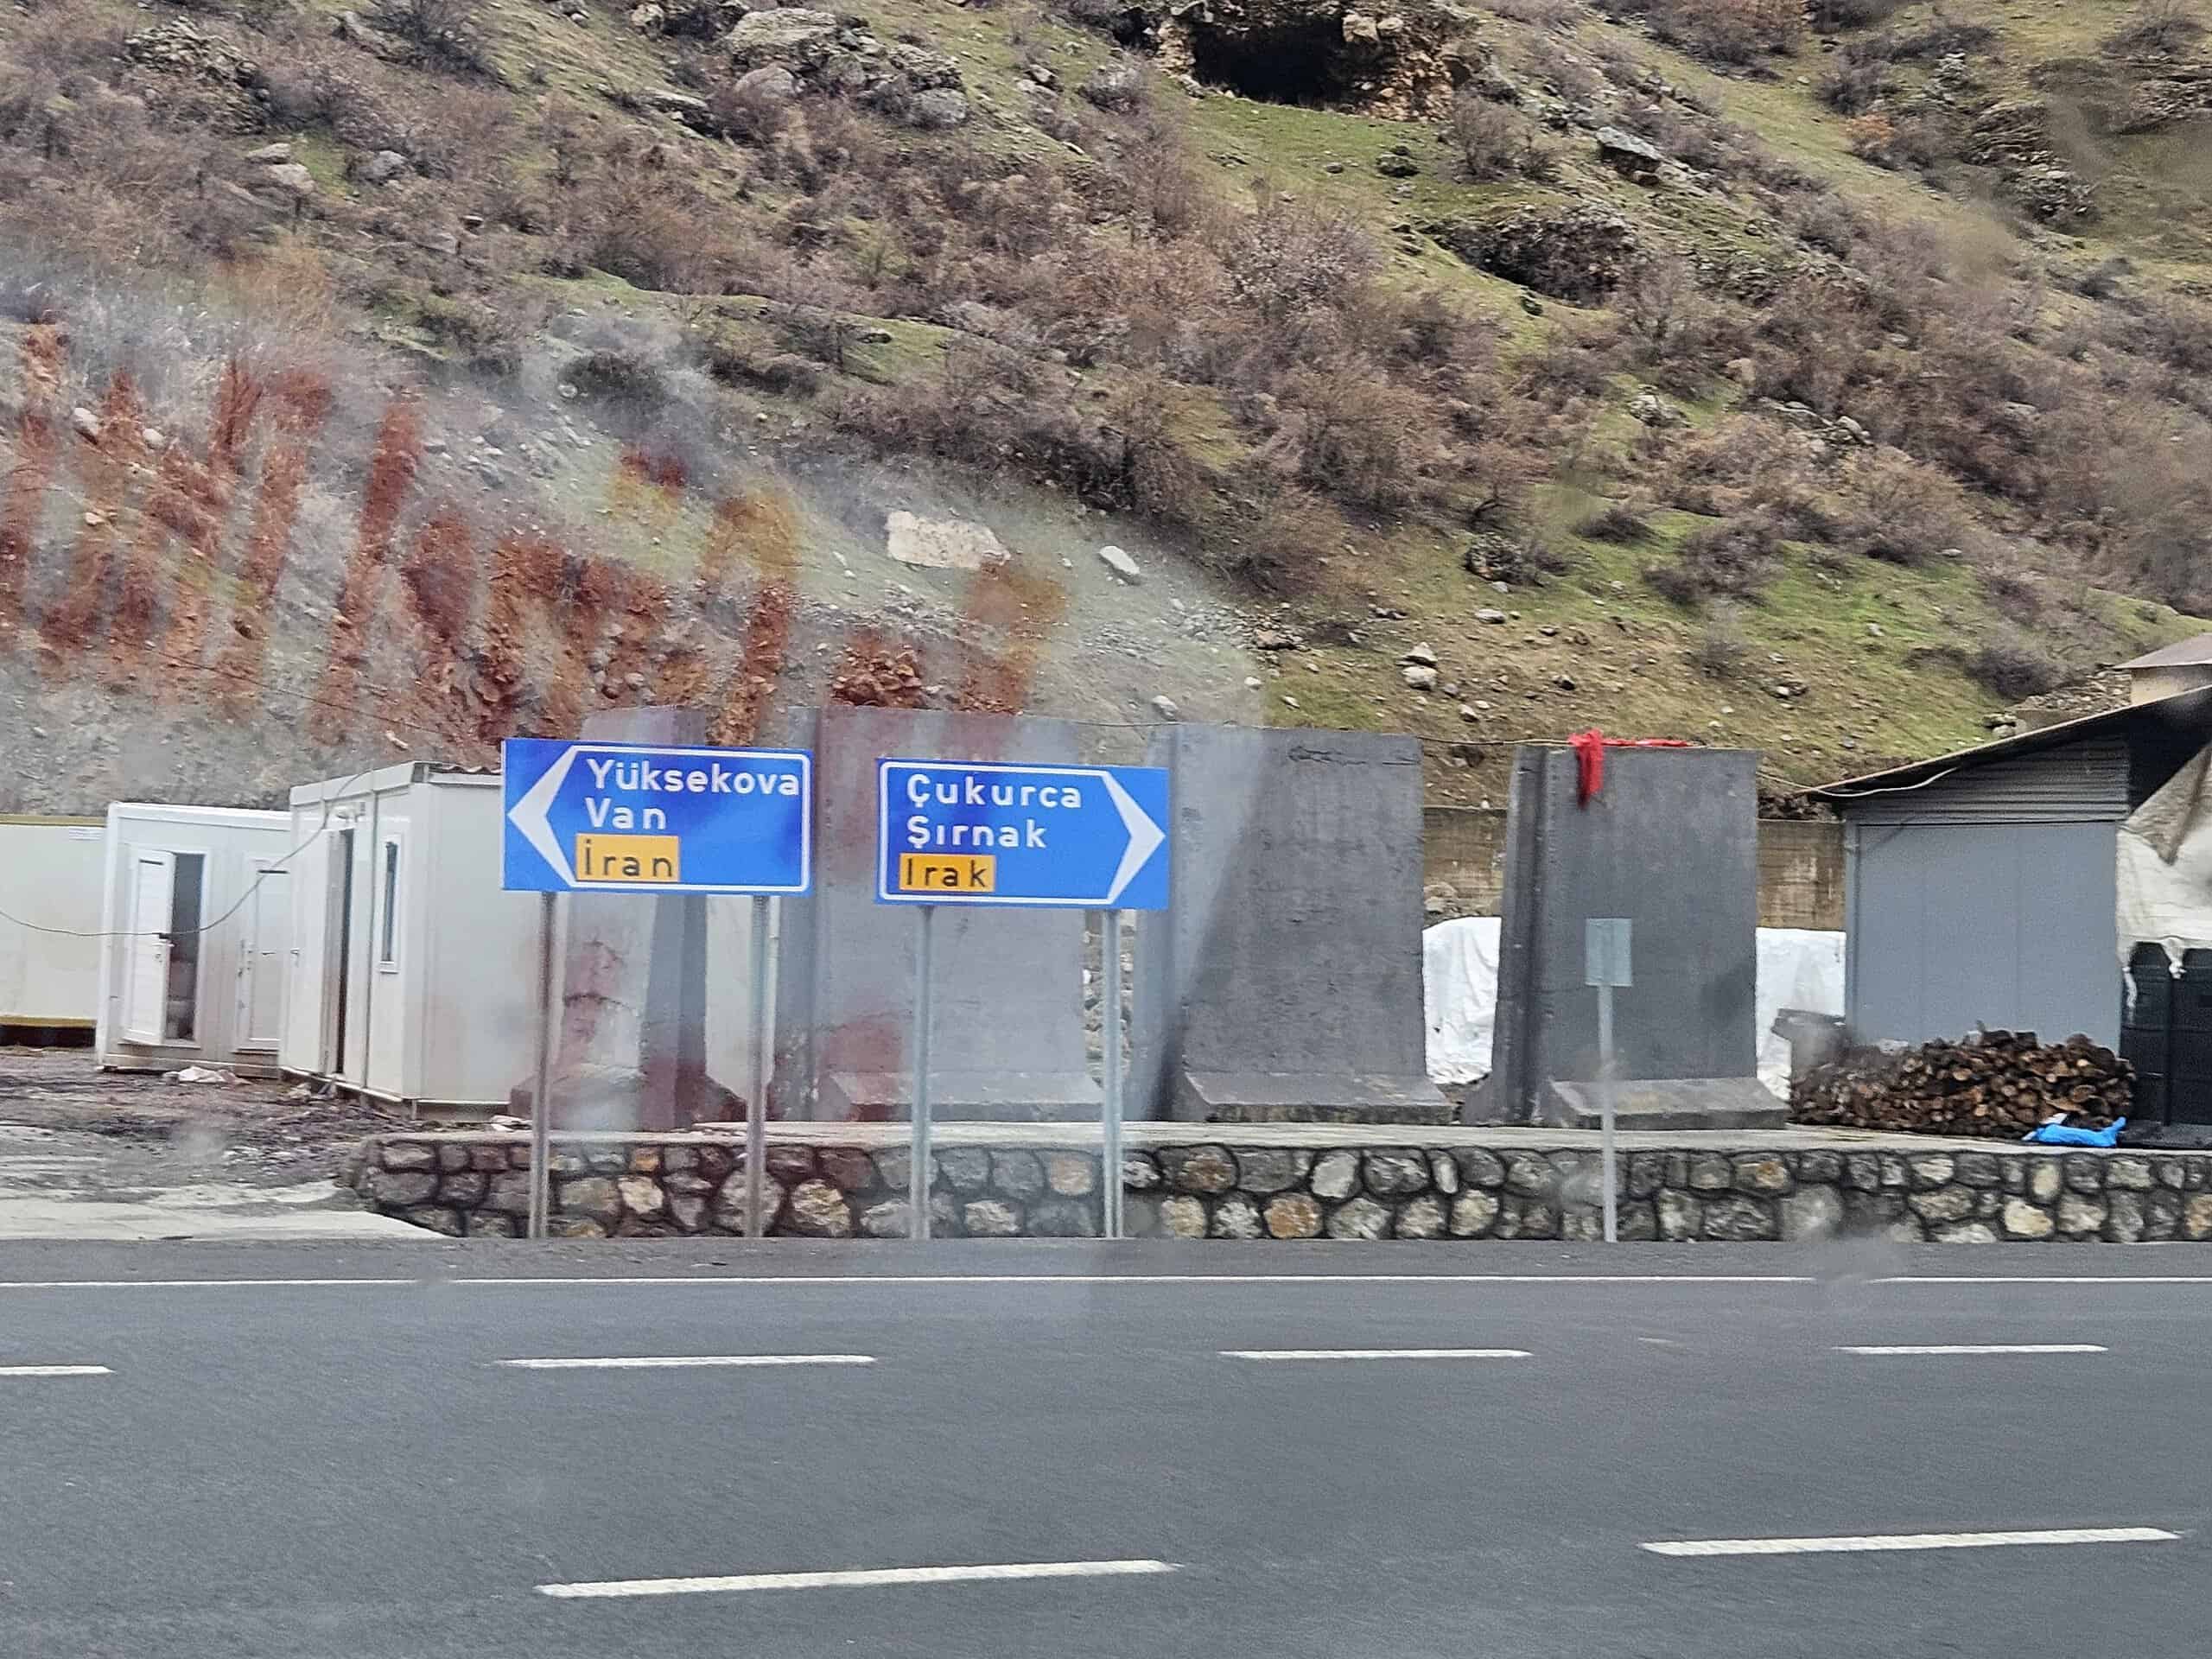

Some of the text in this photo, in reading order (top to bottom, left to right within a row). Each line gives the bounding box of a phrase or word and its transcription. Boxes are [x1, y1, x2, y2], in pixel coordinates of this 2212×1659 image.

[587, 759, 799, 796] Yüksekova
[907, 774, 1081, 808] Çukurca
[584, 798, 667, 830] Van
[907, 815, 1047, 849] Şırnak
[584, 839, 673, 877] İran
[906, 858, 988, 887] Irak
